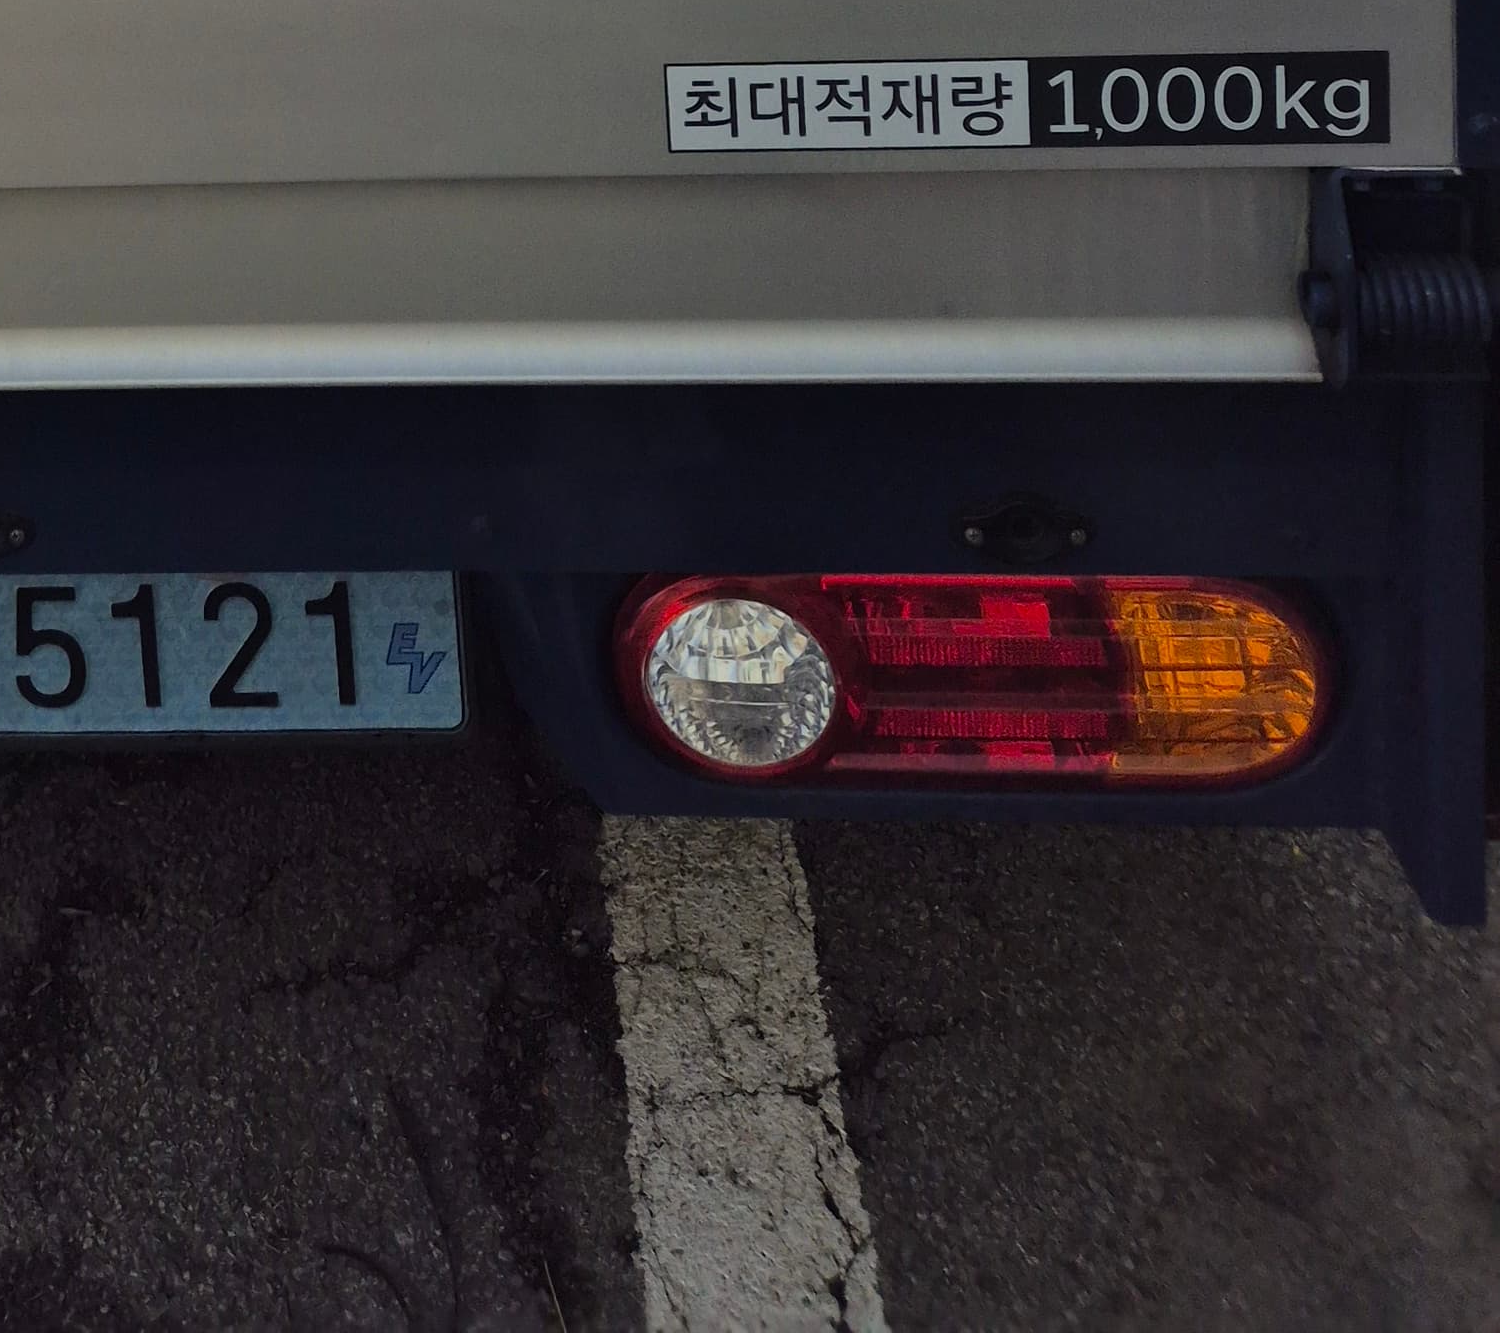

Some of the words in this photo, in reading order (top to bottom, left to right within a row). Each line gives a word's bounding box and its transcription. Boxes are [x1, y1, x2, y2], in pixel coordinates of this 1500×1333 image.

[683, 72, 1014, 138] 최대적재량
[1047, 64, 1370, 140] 1,000kg
[14, 580, 357, 709] 5121
[386, 622, 445, 694] EV
